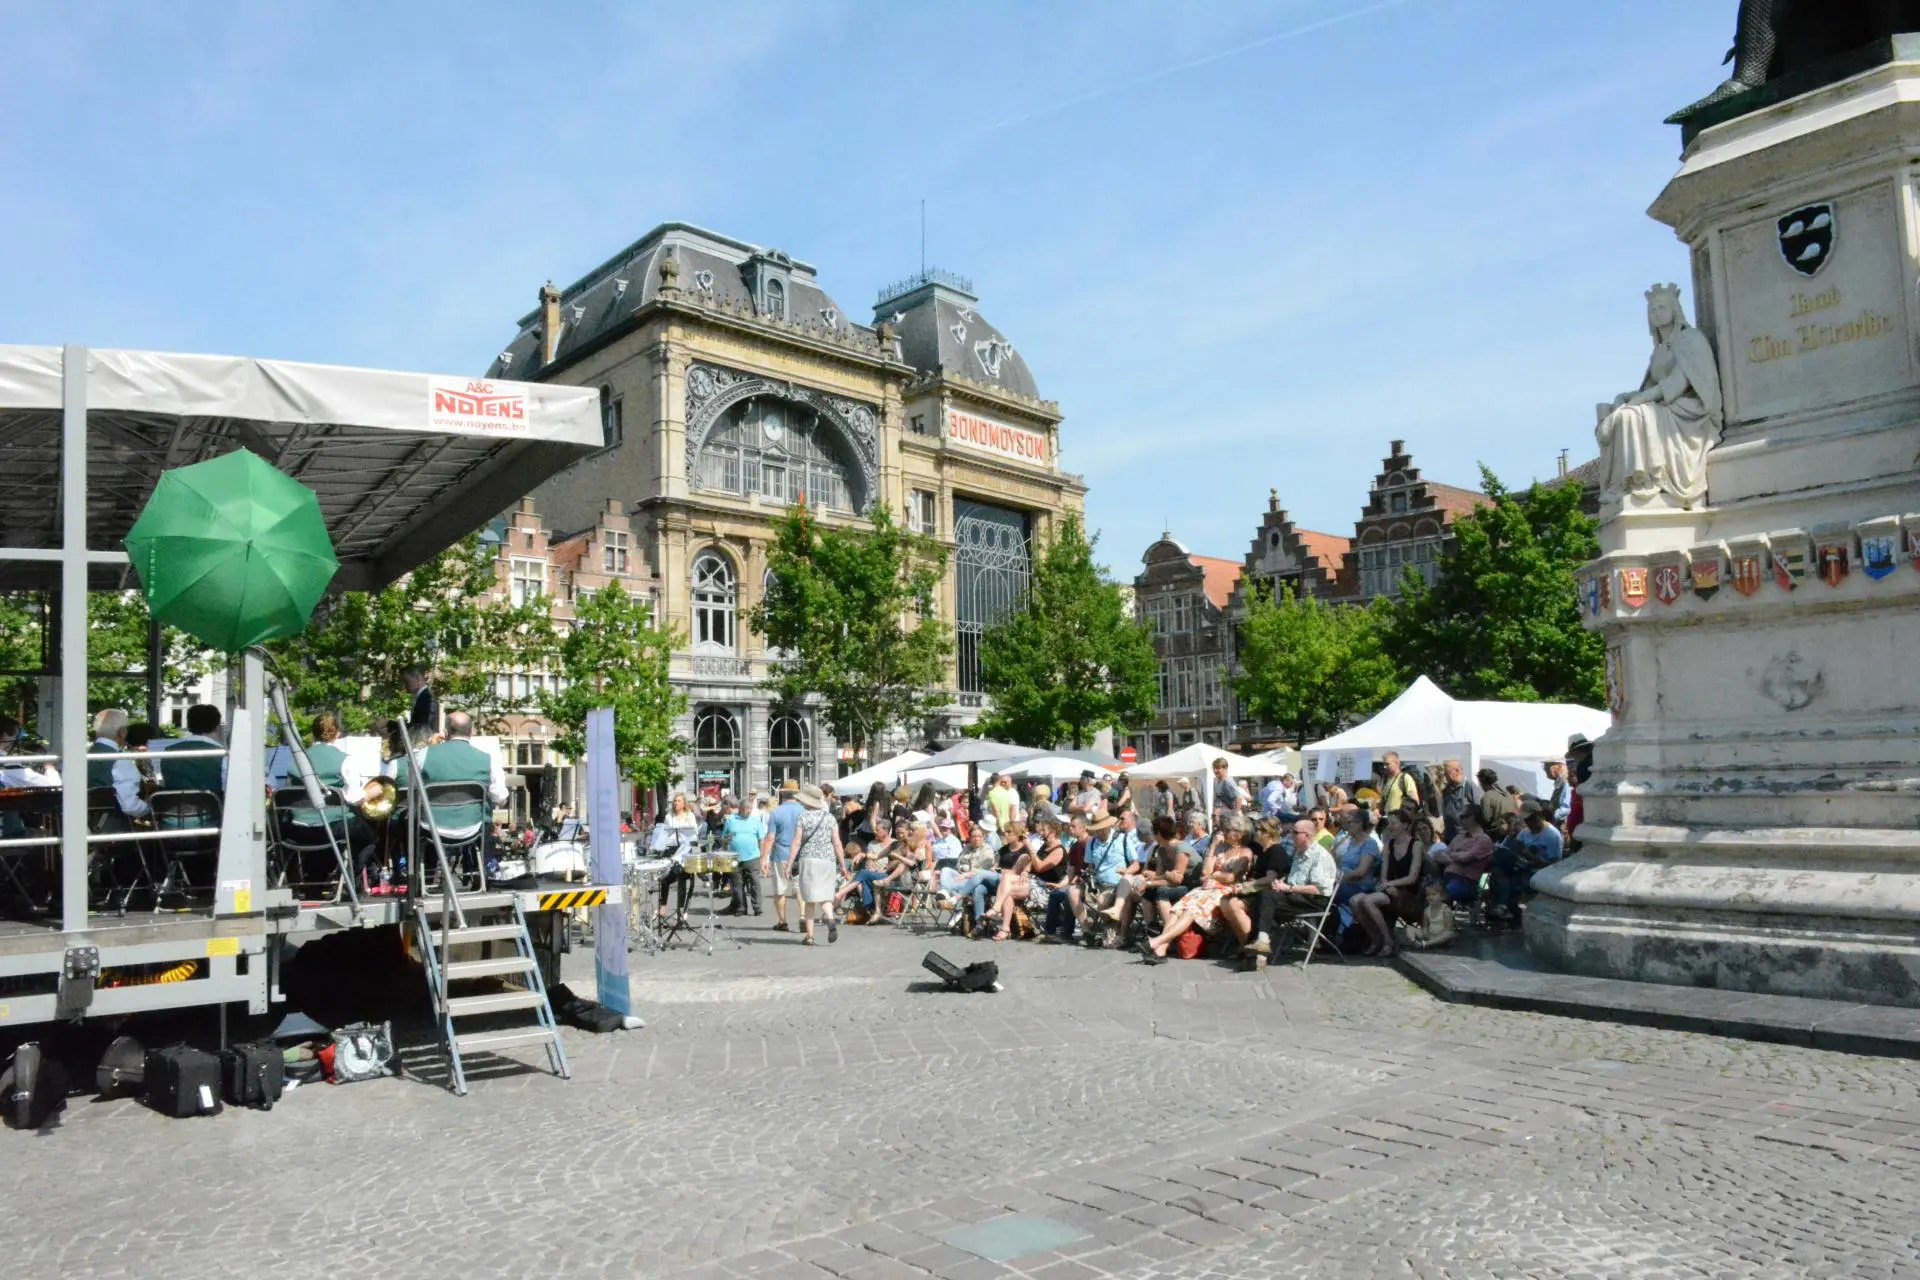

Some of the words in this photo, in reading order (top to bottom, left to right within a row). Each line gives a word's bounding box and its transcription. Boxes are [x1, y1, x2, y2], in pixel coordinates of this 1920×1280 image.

[466, 382, 494, 394] A&C
[434, 389, 524, 418] NOYENS
[434, 419, 526, 431] www.noyens.be
